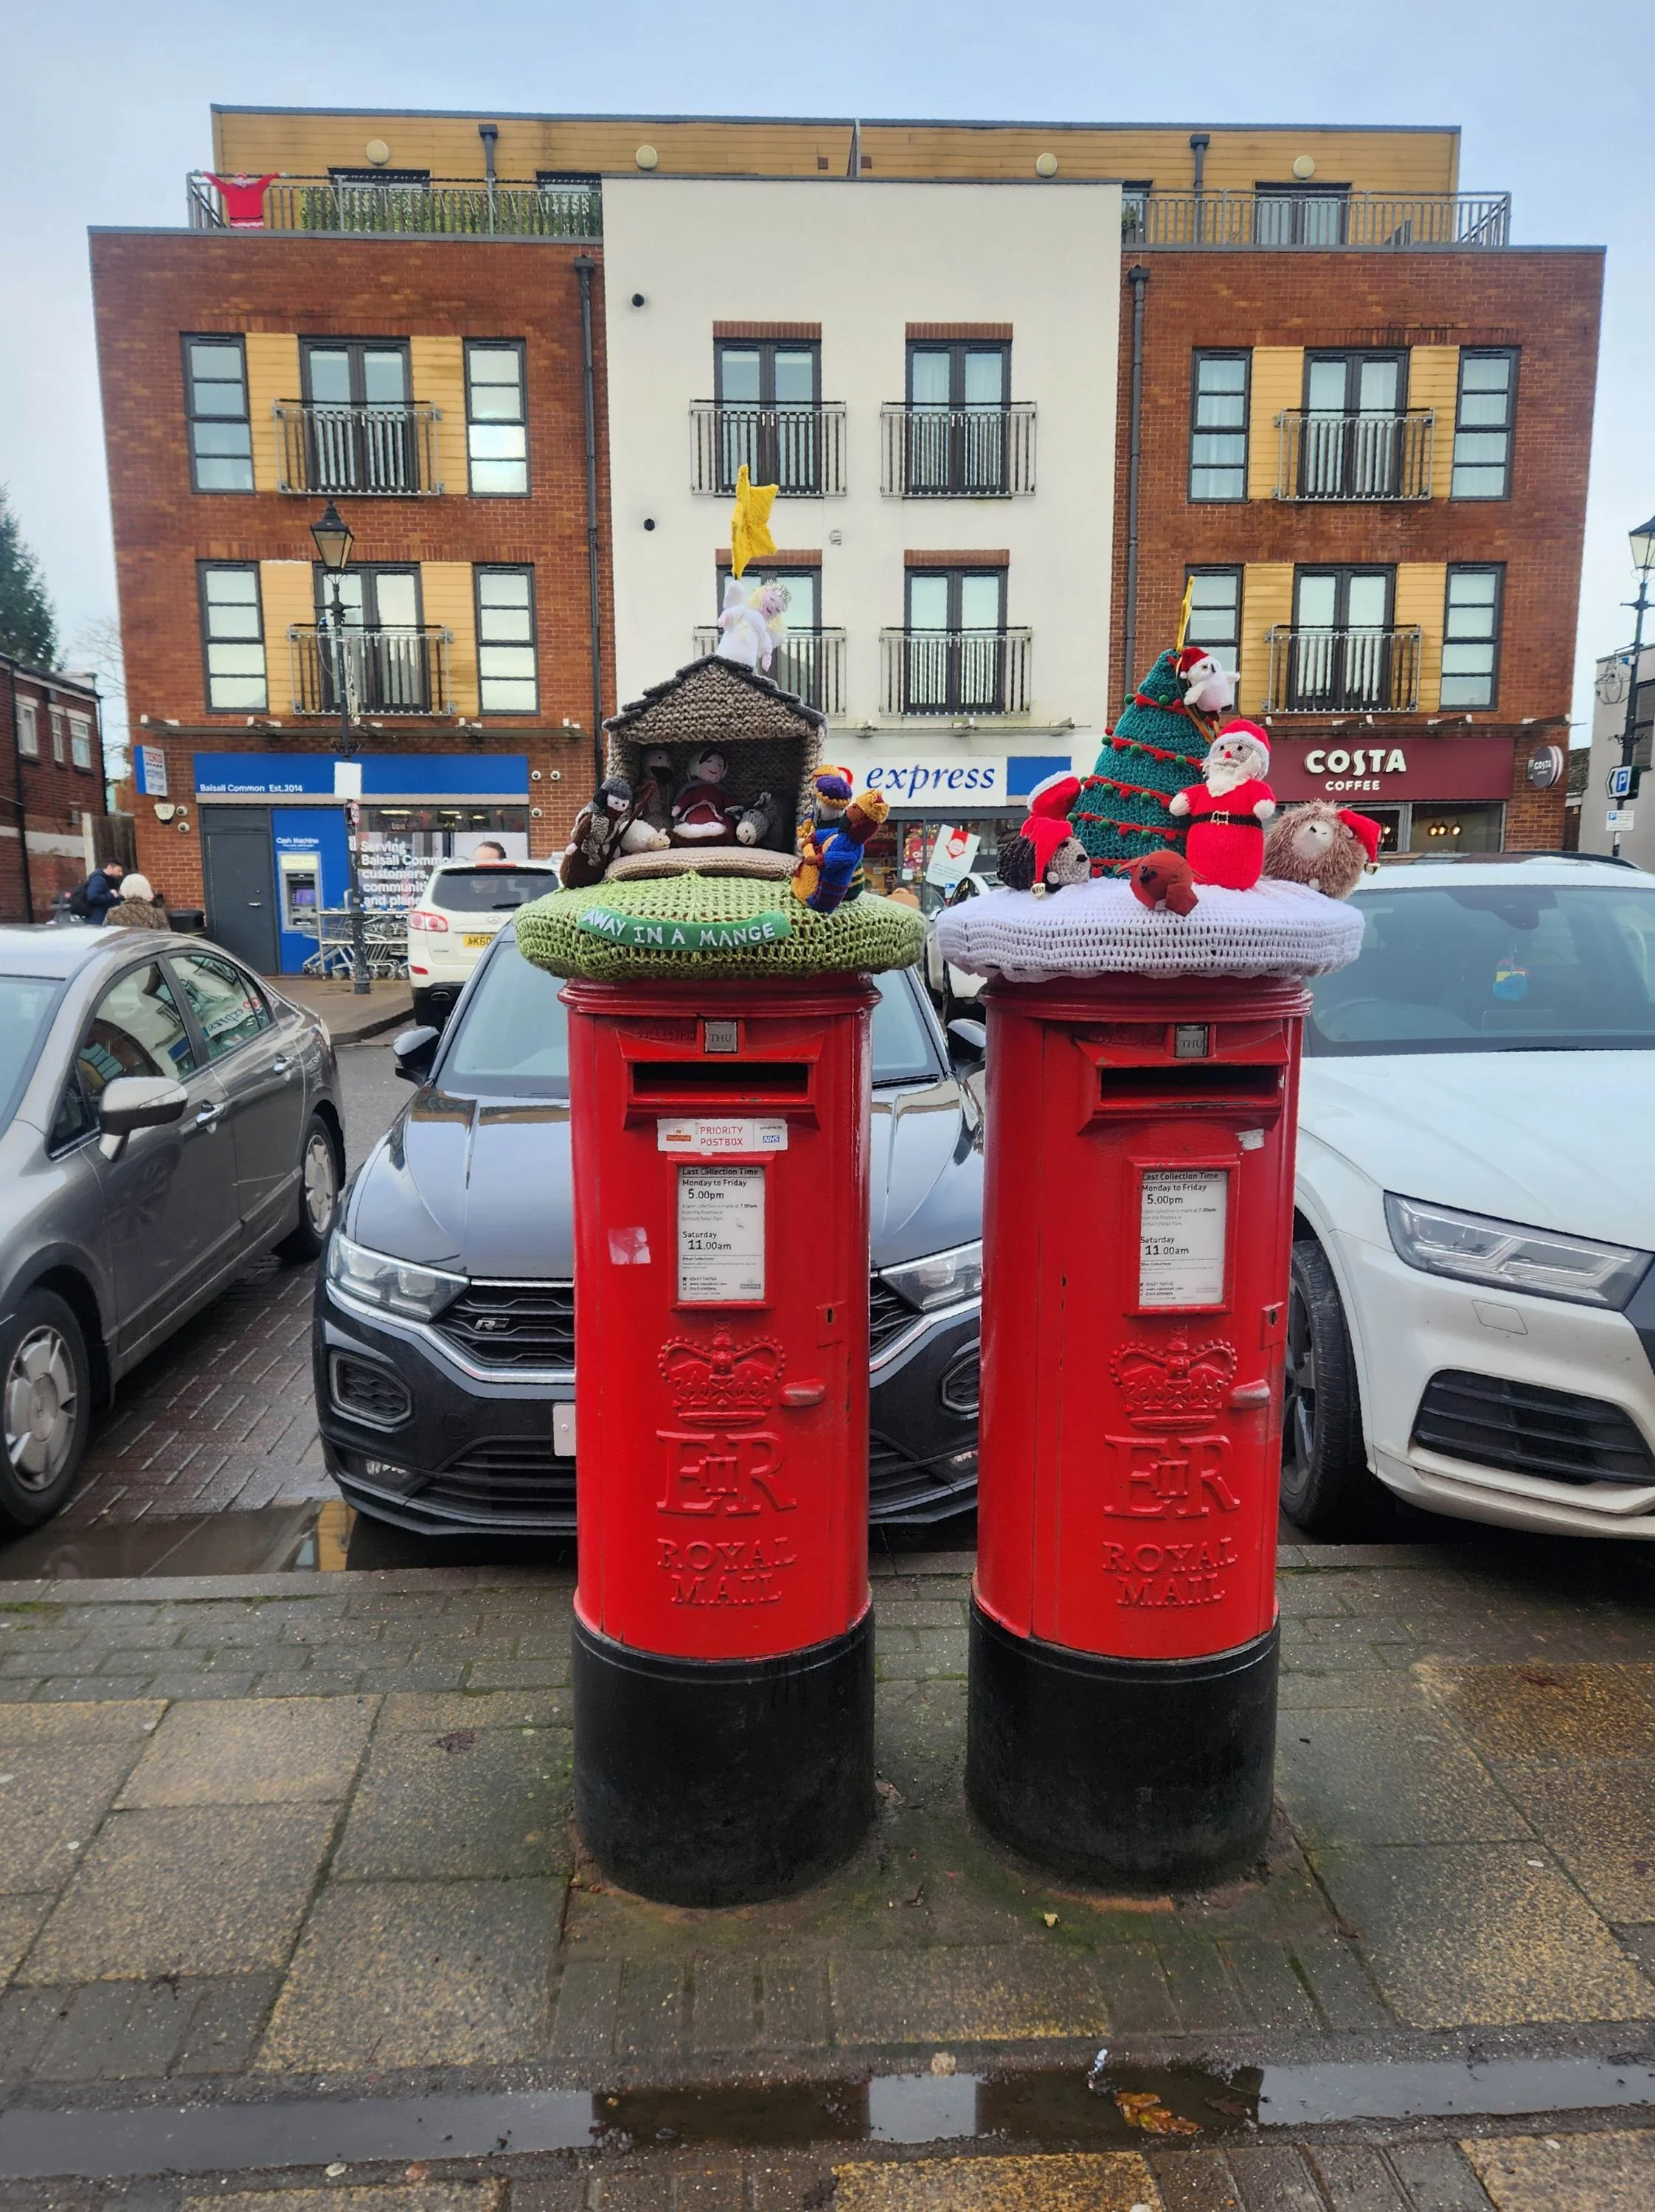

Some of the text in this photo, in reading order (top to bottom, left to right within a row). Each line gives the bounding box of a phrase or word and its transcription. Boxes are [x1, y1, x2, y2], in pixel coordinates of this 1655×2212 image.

[1304, 749, 1407, 776] COSTA
[1534, 759, 1552, 770] COSTA
[866, 764, 995, 799] express
[1325, 780, 1381, 791] COFFEE
[200, 784, 303, 793] Balsall Common Est.2014
[361, 839, 406, 854] Serving
[361, 853, 449, 866] Balsall Commo
[362, 869, 429, 880] customers,
[364, 895, 420, 908] and plane
[581, 909, 775, 947] AWAY IN A MANGE
[709, 1034, 732, 1043] THU
[1180, 1040, 1203, 1048] THU
[700, 1127, 743, 1135] PRIORITY
[700, 1138, 743, 1147] POSTBOX
[763, 1135, 780, 1143] NHS
[700, 1168, 738, 1176] Collection
[1160, 1172, 1198, 1180] Collection
[1199, 1172, 1218, 1180] Time
[682, 1180, 712, 1188] Monday
[723, 1180, 747, 1188] Friday
[1142, 1184, 1171, 1192] Monday
[1182, 1183, 1207, 1192] Friday
[688, 1189, 724, 1200] 5.00pm
[1147, 1194, 1184, 1206] 5.00pm
[682, 1231, 717, 1239] Saturday
[687, 1239, 732, 1251] 11.00am
[1145, 1245, 1190, 1255] 11.00am
[657, 1537, 798, 1571] ROYAL
[1102, 1537, 1238, 1573] ROYAL
[670, 1573, 783, 1606] MAIL
[1116, 1573, 1226, 1607] MAIL
